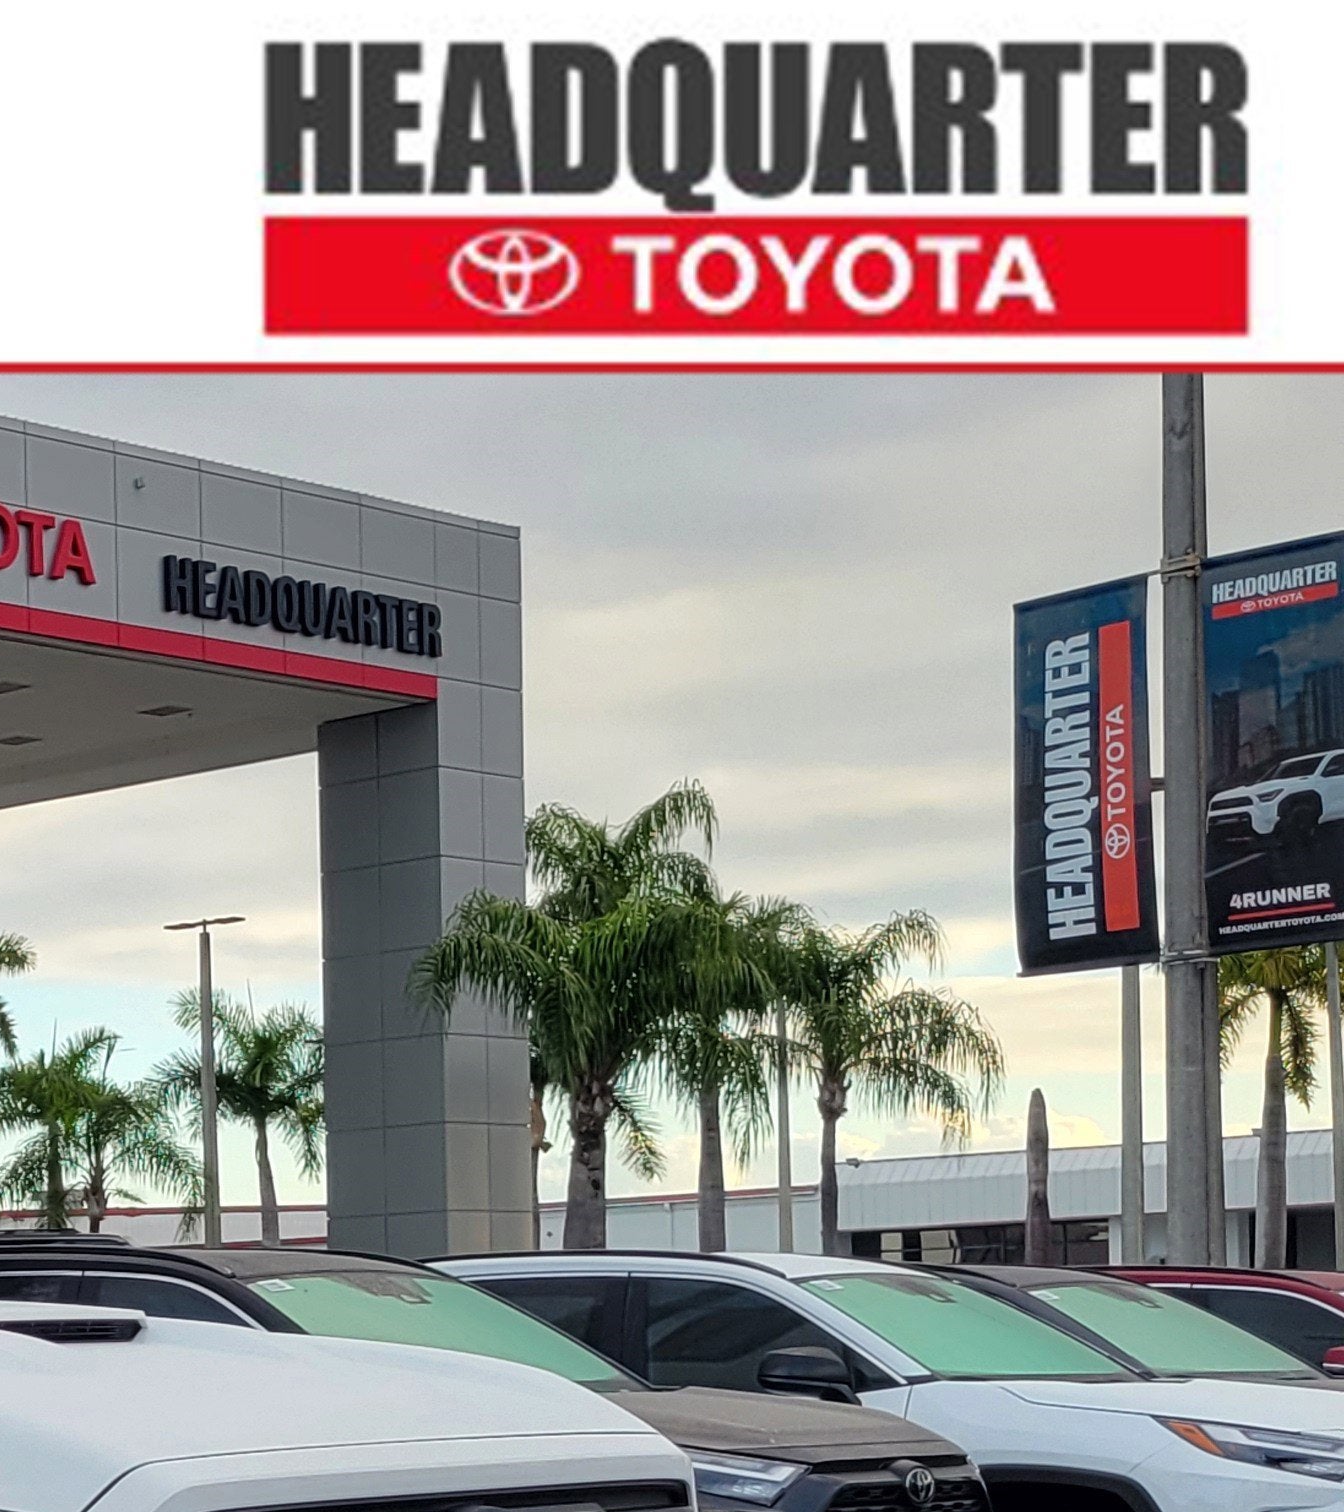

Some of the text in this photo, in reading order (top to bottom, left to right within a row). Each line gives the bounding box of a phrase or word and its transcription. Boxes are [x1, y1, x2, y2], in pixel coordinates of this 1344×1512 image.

[163, 555, 443, 658] HEADQUARTER
[1212, 561, 1337, 604] HEADQUARTER
[1257, 591, 1304, 609] TOYOTA
[1043, 632, 1098, 941] HEADQUARTER
[1105, 703, 1126, 821] TOYOTA
[1229, 882, 1331, 909] 4RUNNER
